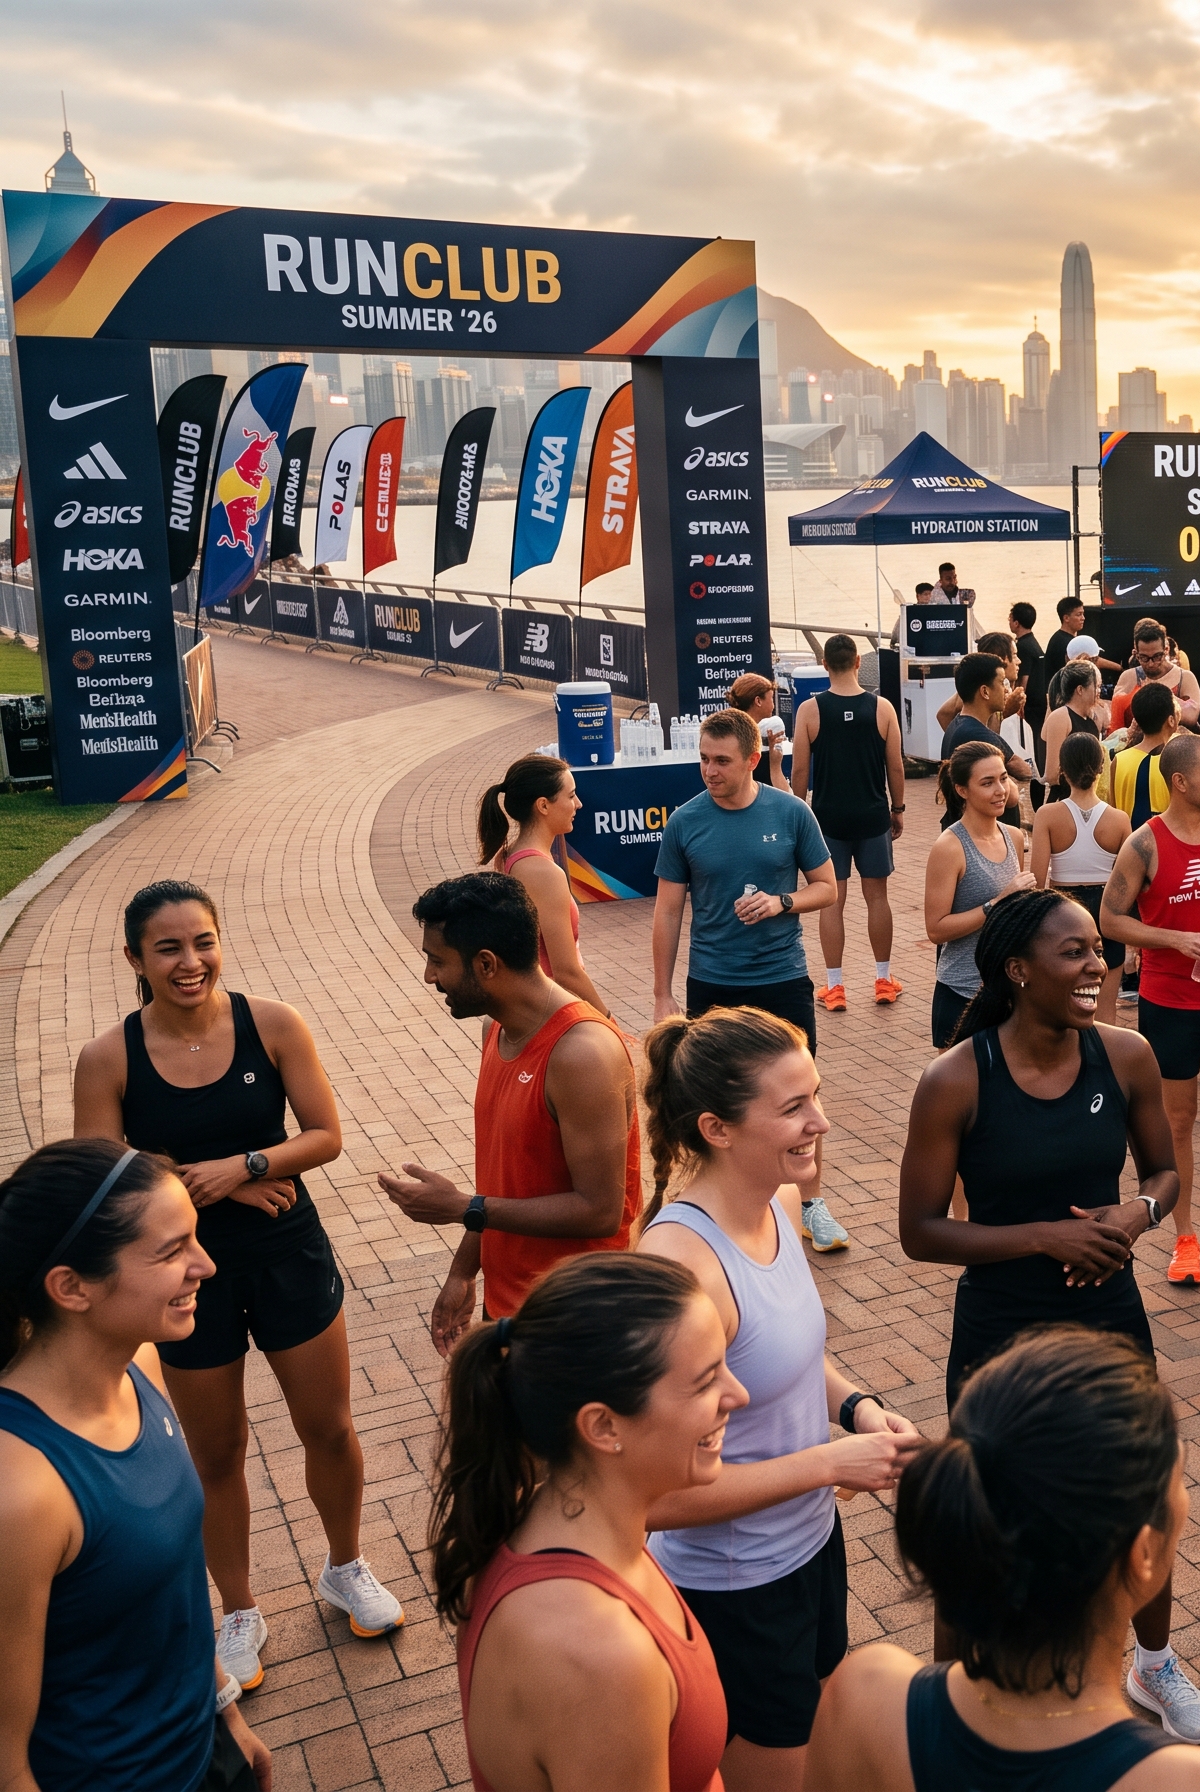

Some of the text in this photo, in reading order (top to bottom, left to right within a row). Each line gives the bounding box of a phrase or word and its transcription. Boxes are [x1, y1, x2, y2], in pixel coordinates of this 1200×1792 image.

[263, 233, 562, 304] RUNCLUB
[341, 304, 454, 332] SUMMER
[169, 420, 202, 532] RUNCLUB
[531, 435, 568, 524] HOKA
[601, 424, 636, 535] STRAVA
[911, 475, 988, 489] RUNCLUB
[688, 520, 751, 536] STRAVA
[911, 518, 1039, 535] HYDRATION STATION
[62, 548, 145, 572] HOKA
[374, 603, 421, 633] RUNCLUB
[71, 626, 152, 643] Bloomberg
[712, 634, 754, 645] REUTERS
[98, 652, 152, 664] REUTERS
[697, 652, 753, 664] Bloomberg
[76, 673, 153, 689] Bloomberg
[619, 831, 664, 845] SUMMER
[1168, 892, 1193, 905] new
